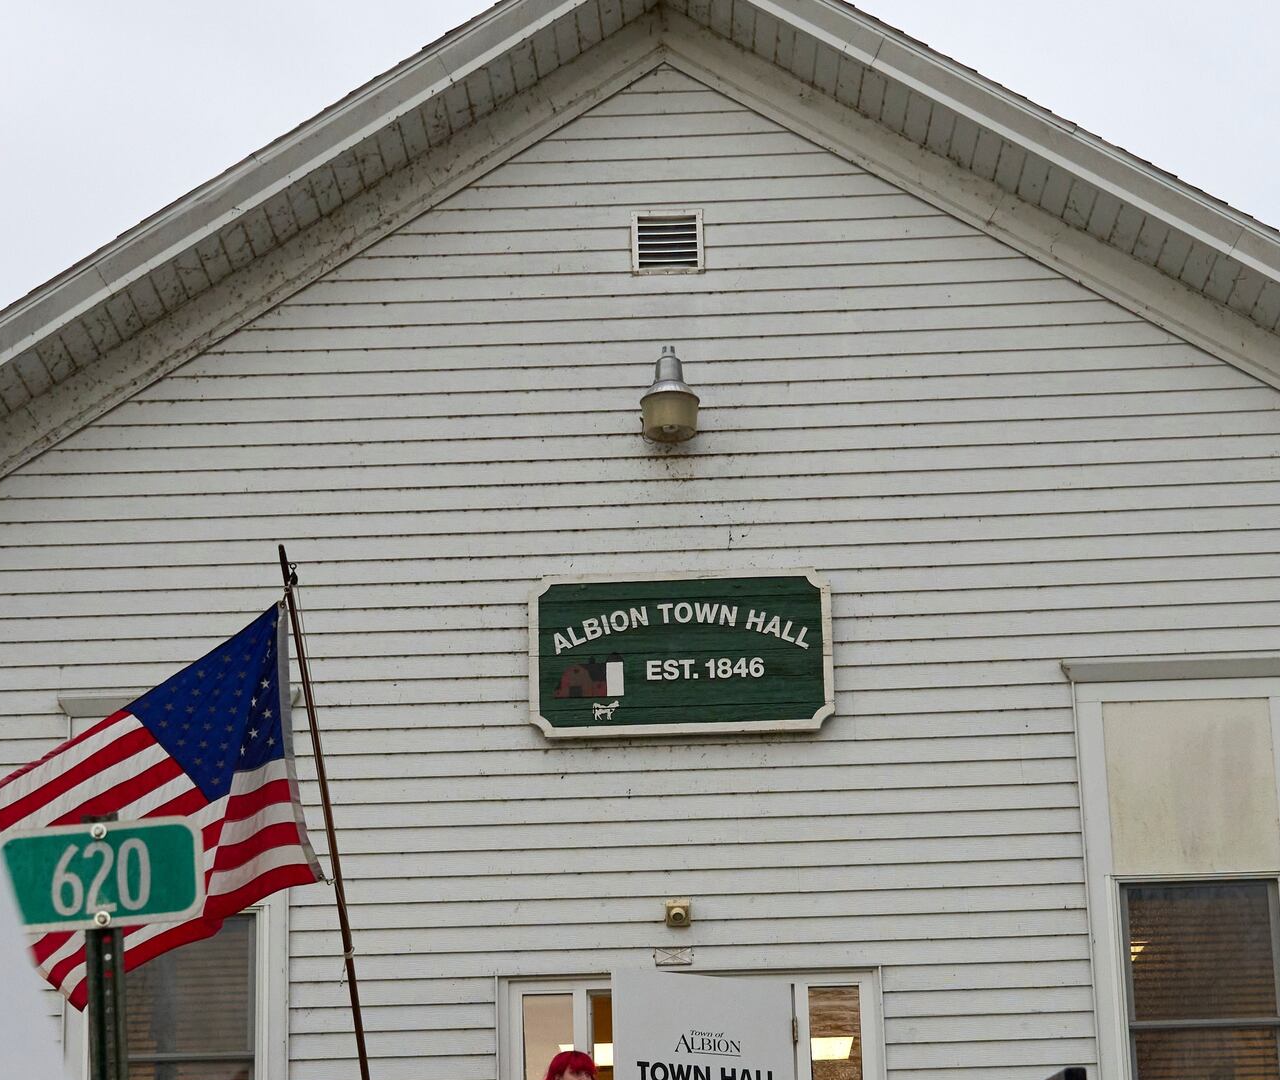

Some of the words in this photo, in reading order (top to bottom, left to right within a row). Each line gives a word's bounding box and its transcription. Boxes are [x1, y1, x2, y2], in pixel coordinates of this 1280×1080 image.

[553, 606, 649, 655] ALBION
[657, 602, 738, 627] TOWN
[745, 609, 810, 650] HALL
[646, 659, 699, 681] EST.
[705, 657, 765, 679] 1846
[51, 838, 151, 916] 620
[674, 1034, 741, 1053] ALBION
[690, 1029, 714, 1038] Town
